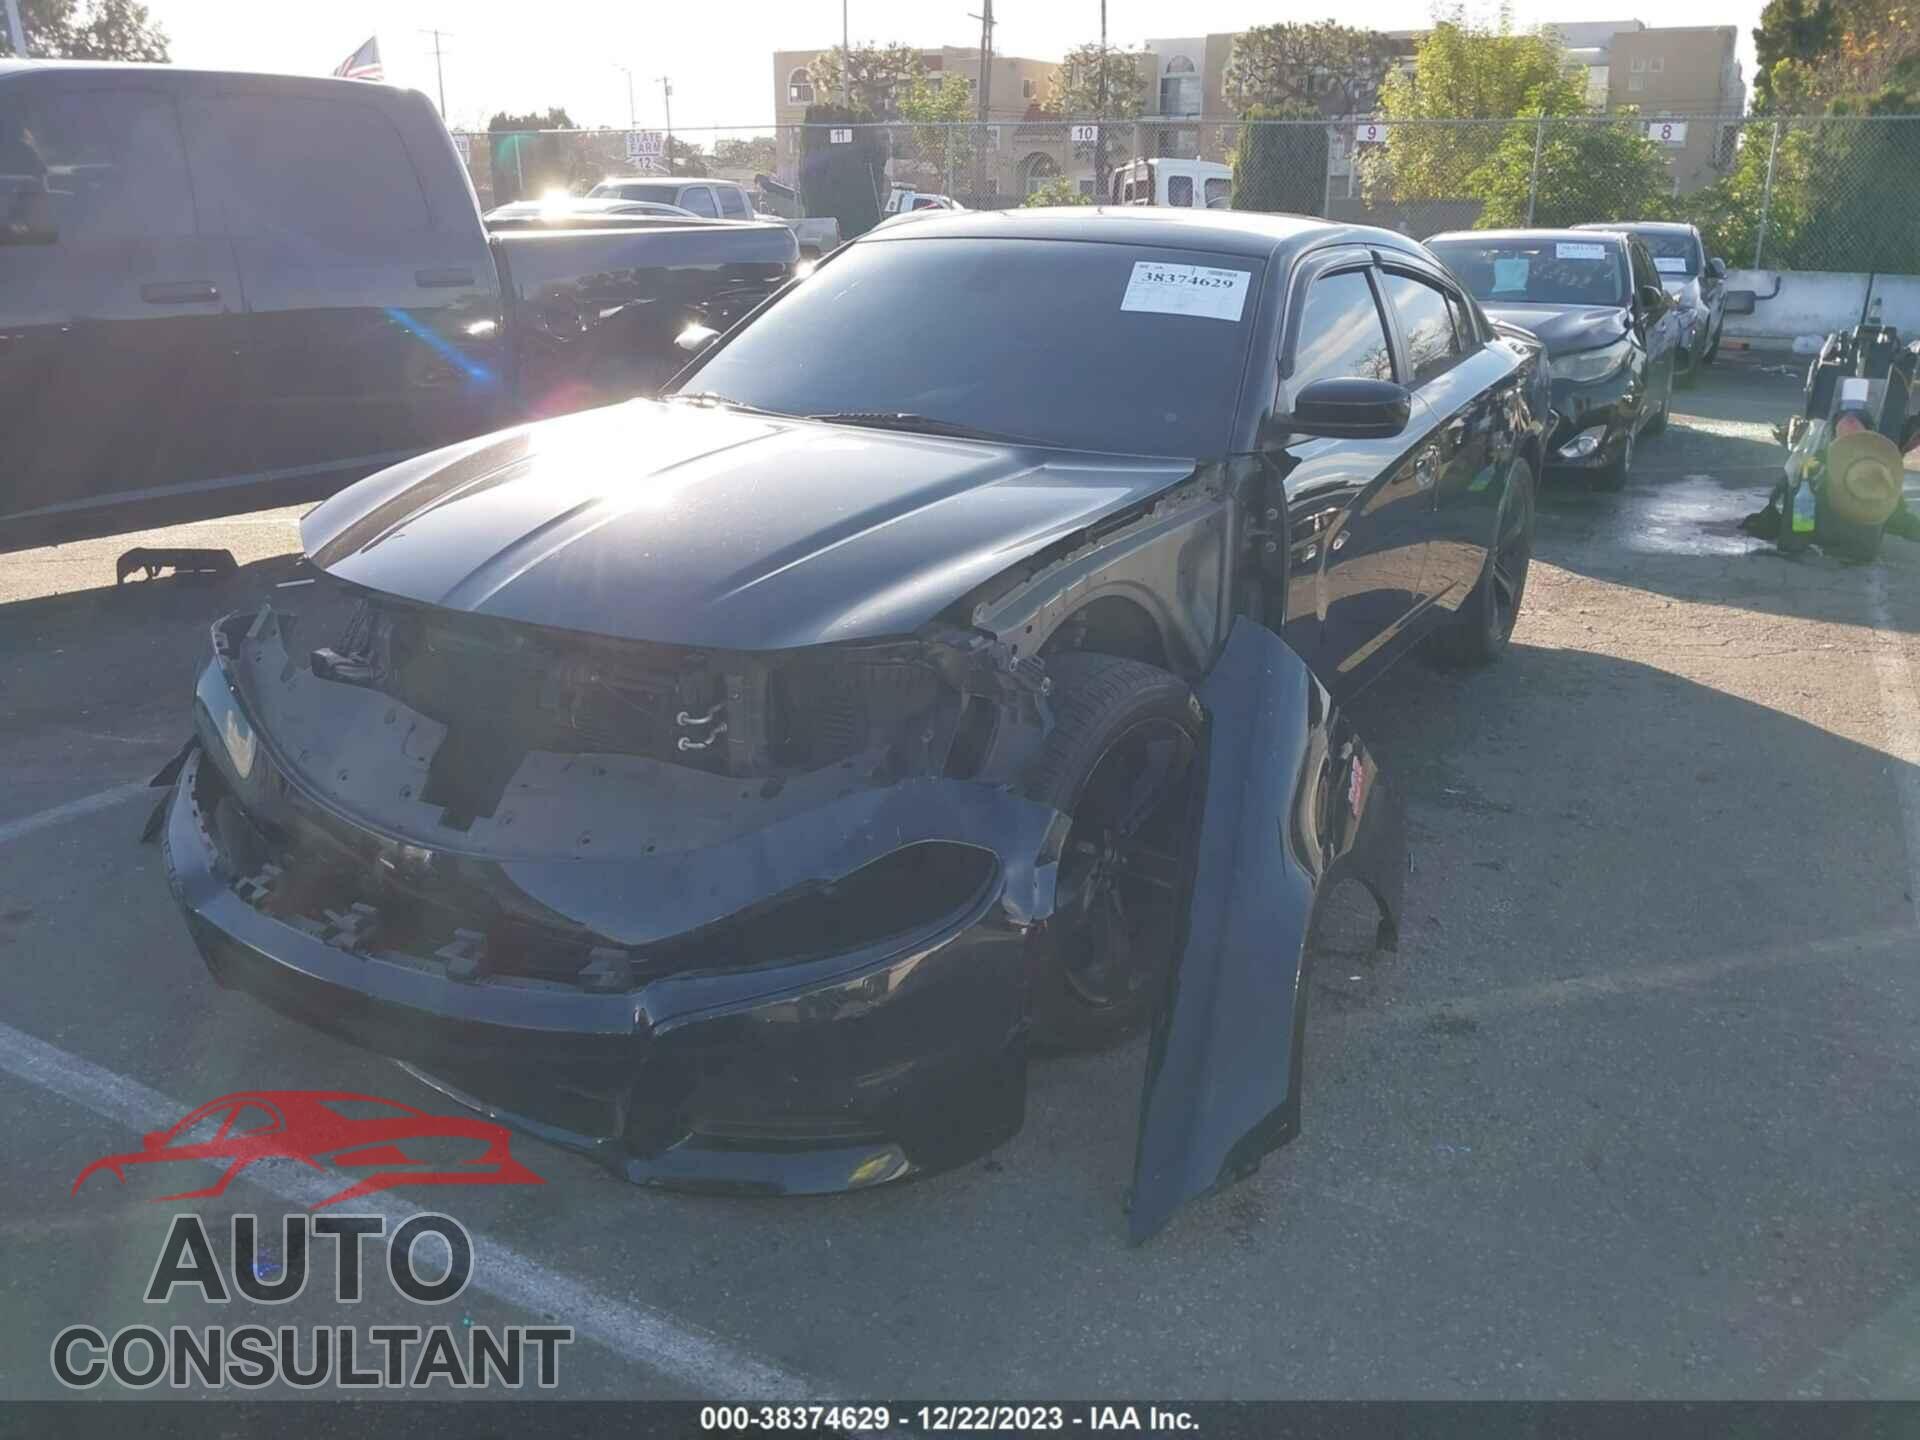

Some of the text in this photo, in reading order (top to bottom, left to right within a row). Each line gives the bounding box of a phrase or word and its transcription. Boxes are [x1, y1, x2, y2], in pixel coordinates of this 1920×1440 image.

[628, 132, 663, 143] STATE
[1078, 126, 1093, 140] 10
[1367, 126, 1377, 140] 9
[1661, 124, 1672, 140] 8
[630, 143, 661, 153] FARM
[639, 157, 651, 168] 12
[1142, 272, 1234, 289] 38374629
